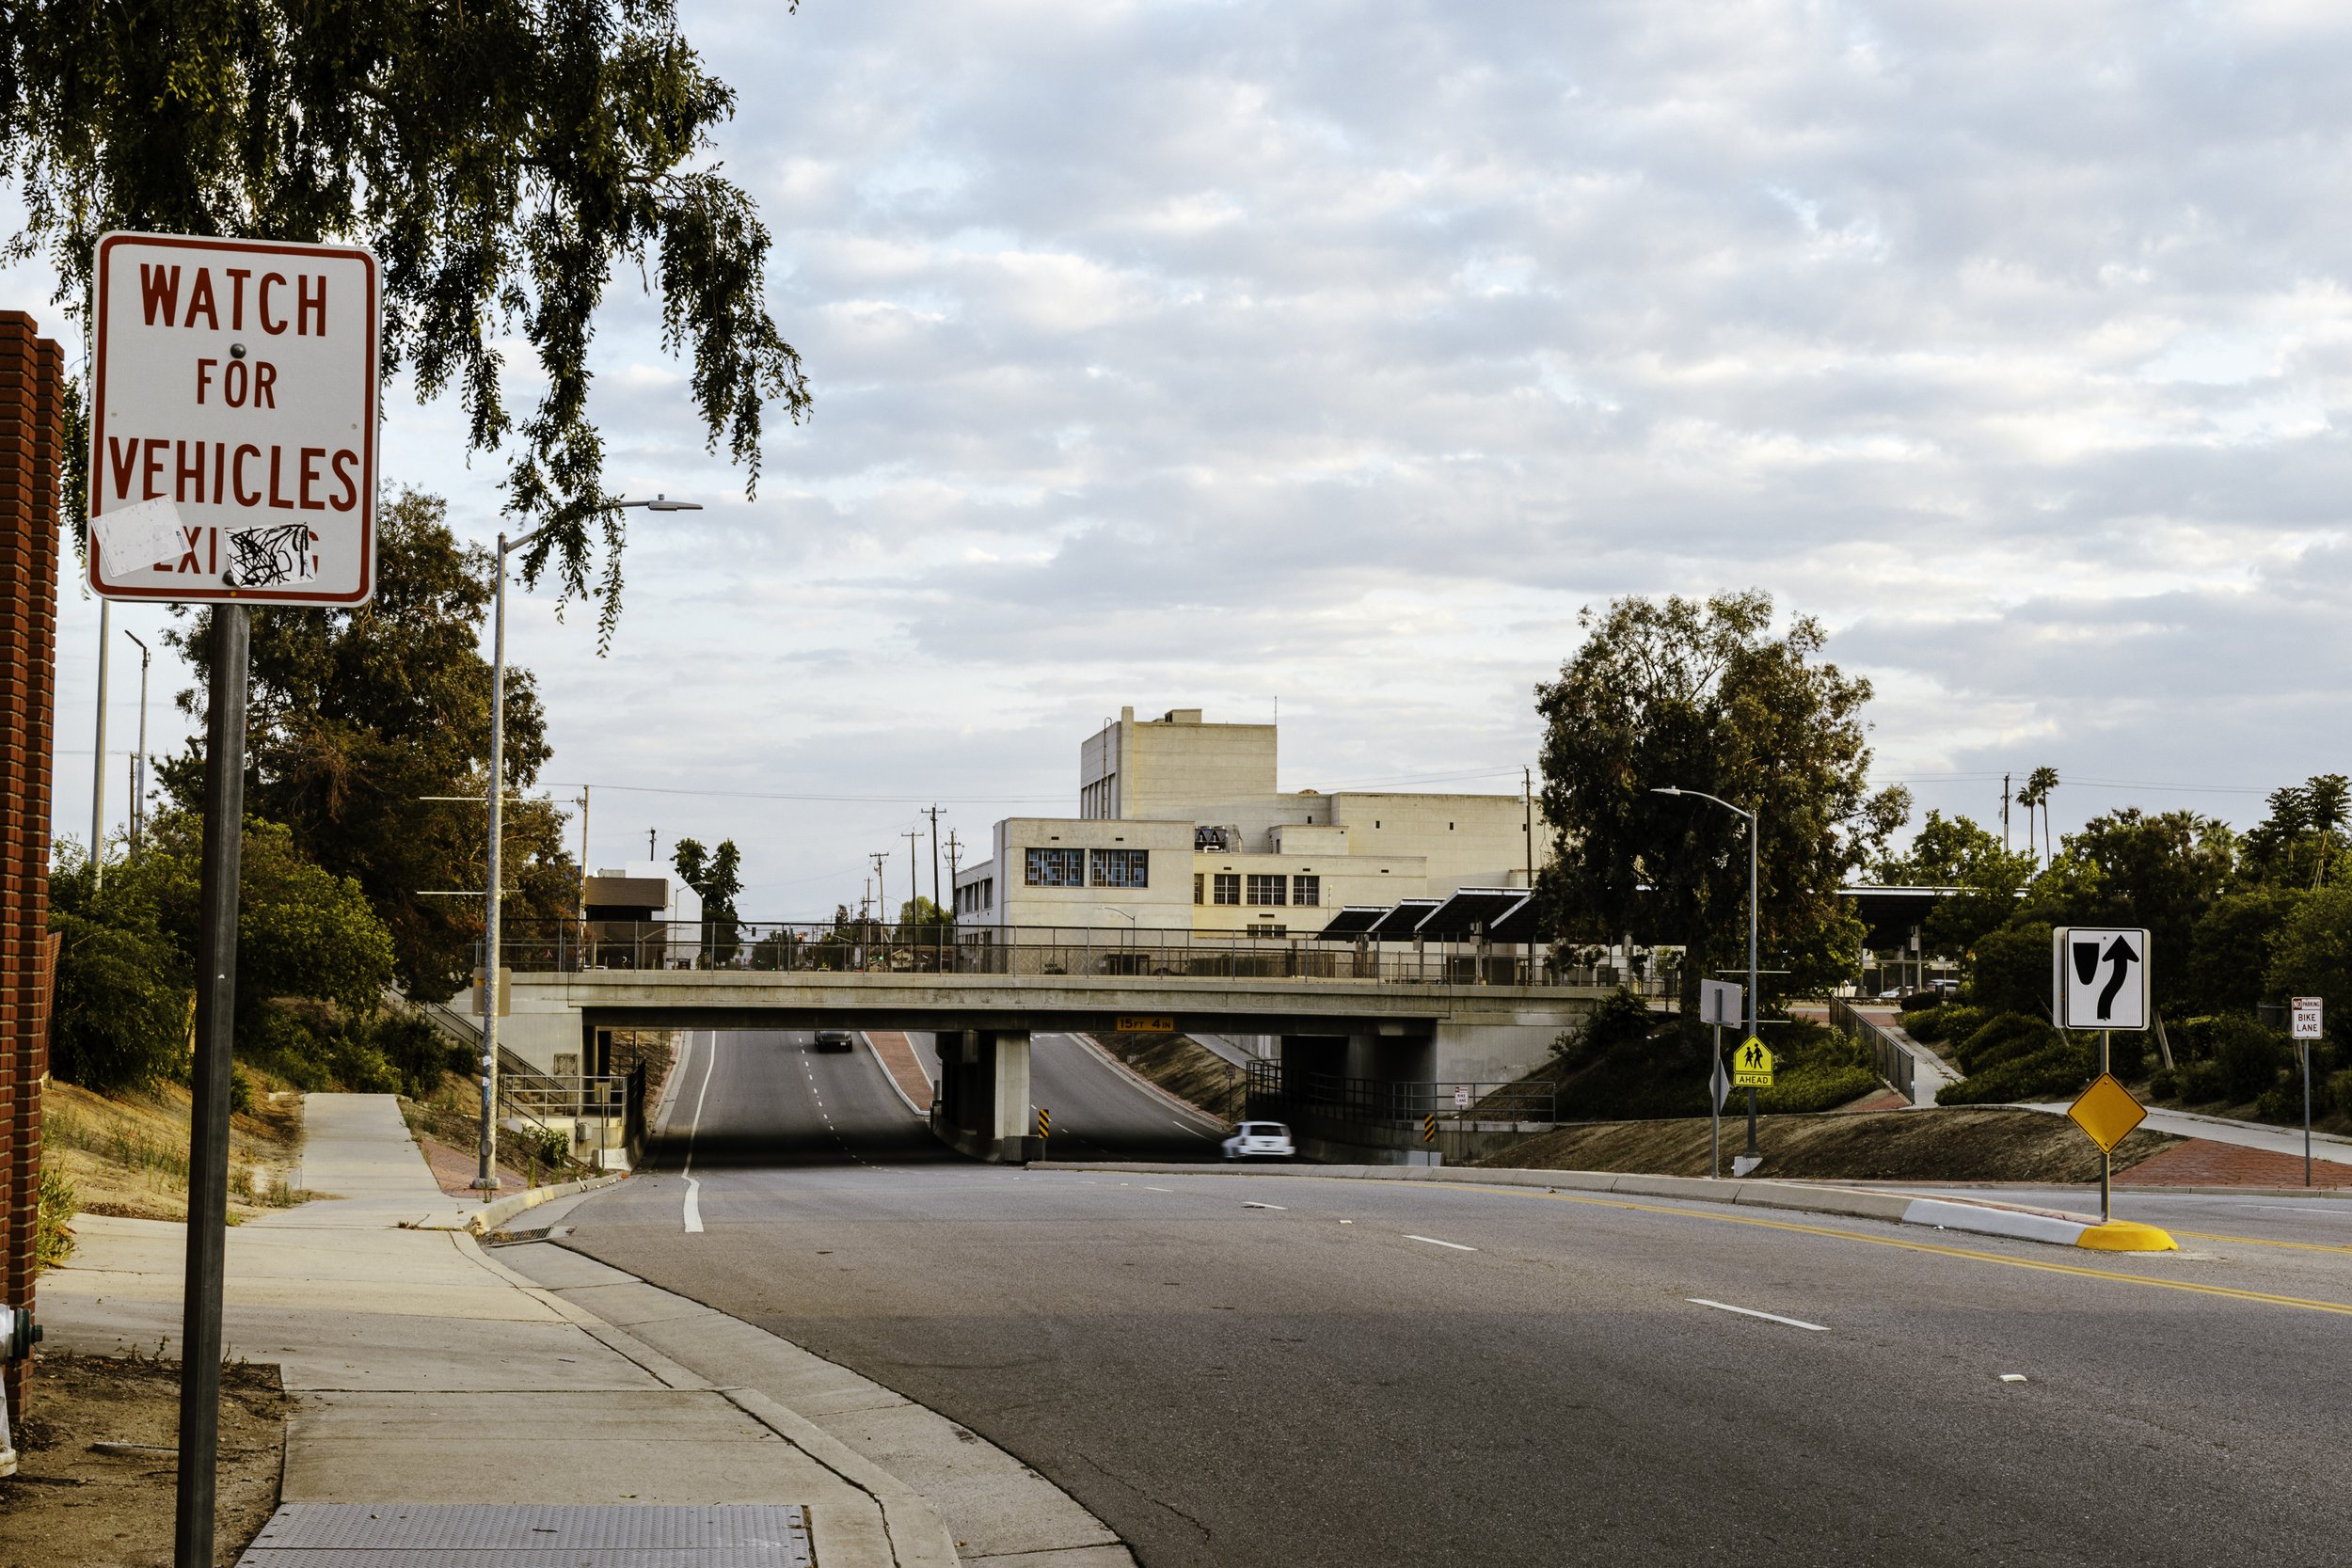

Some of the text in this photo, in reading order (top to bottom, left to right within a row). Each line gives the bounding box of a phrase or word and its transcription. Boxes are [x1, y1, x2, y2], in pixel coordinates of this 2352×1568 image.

[140, 263, 326, 337] WATCH
[197, 358, 277, 409] FOR
[108, 436, 358, 512] VEHICLES
[1740, 1075, 1768, 1084] AHEAD
